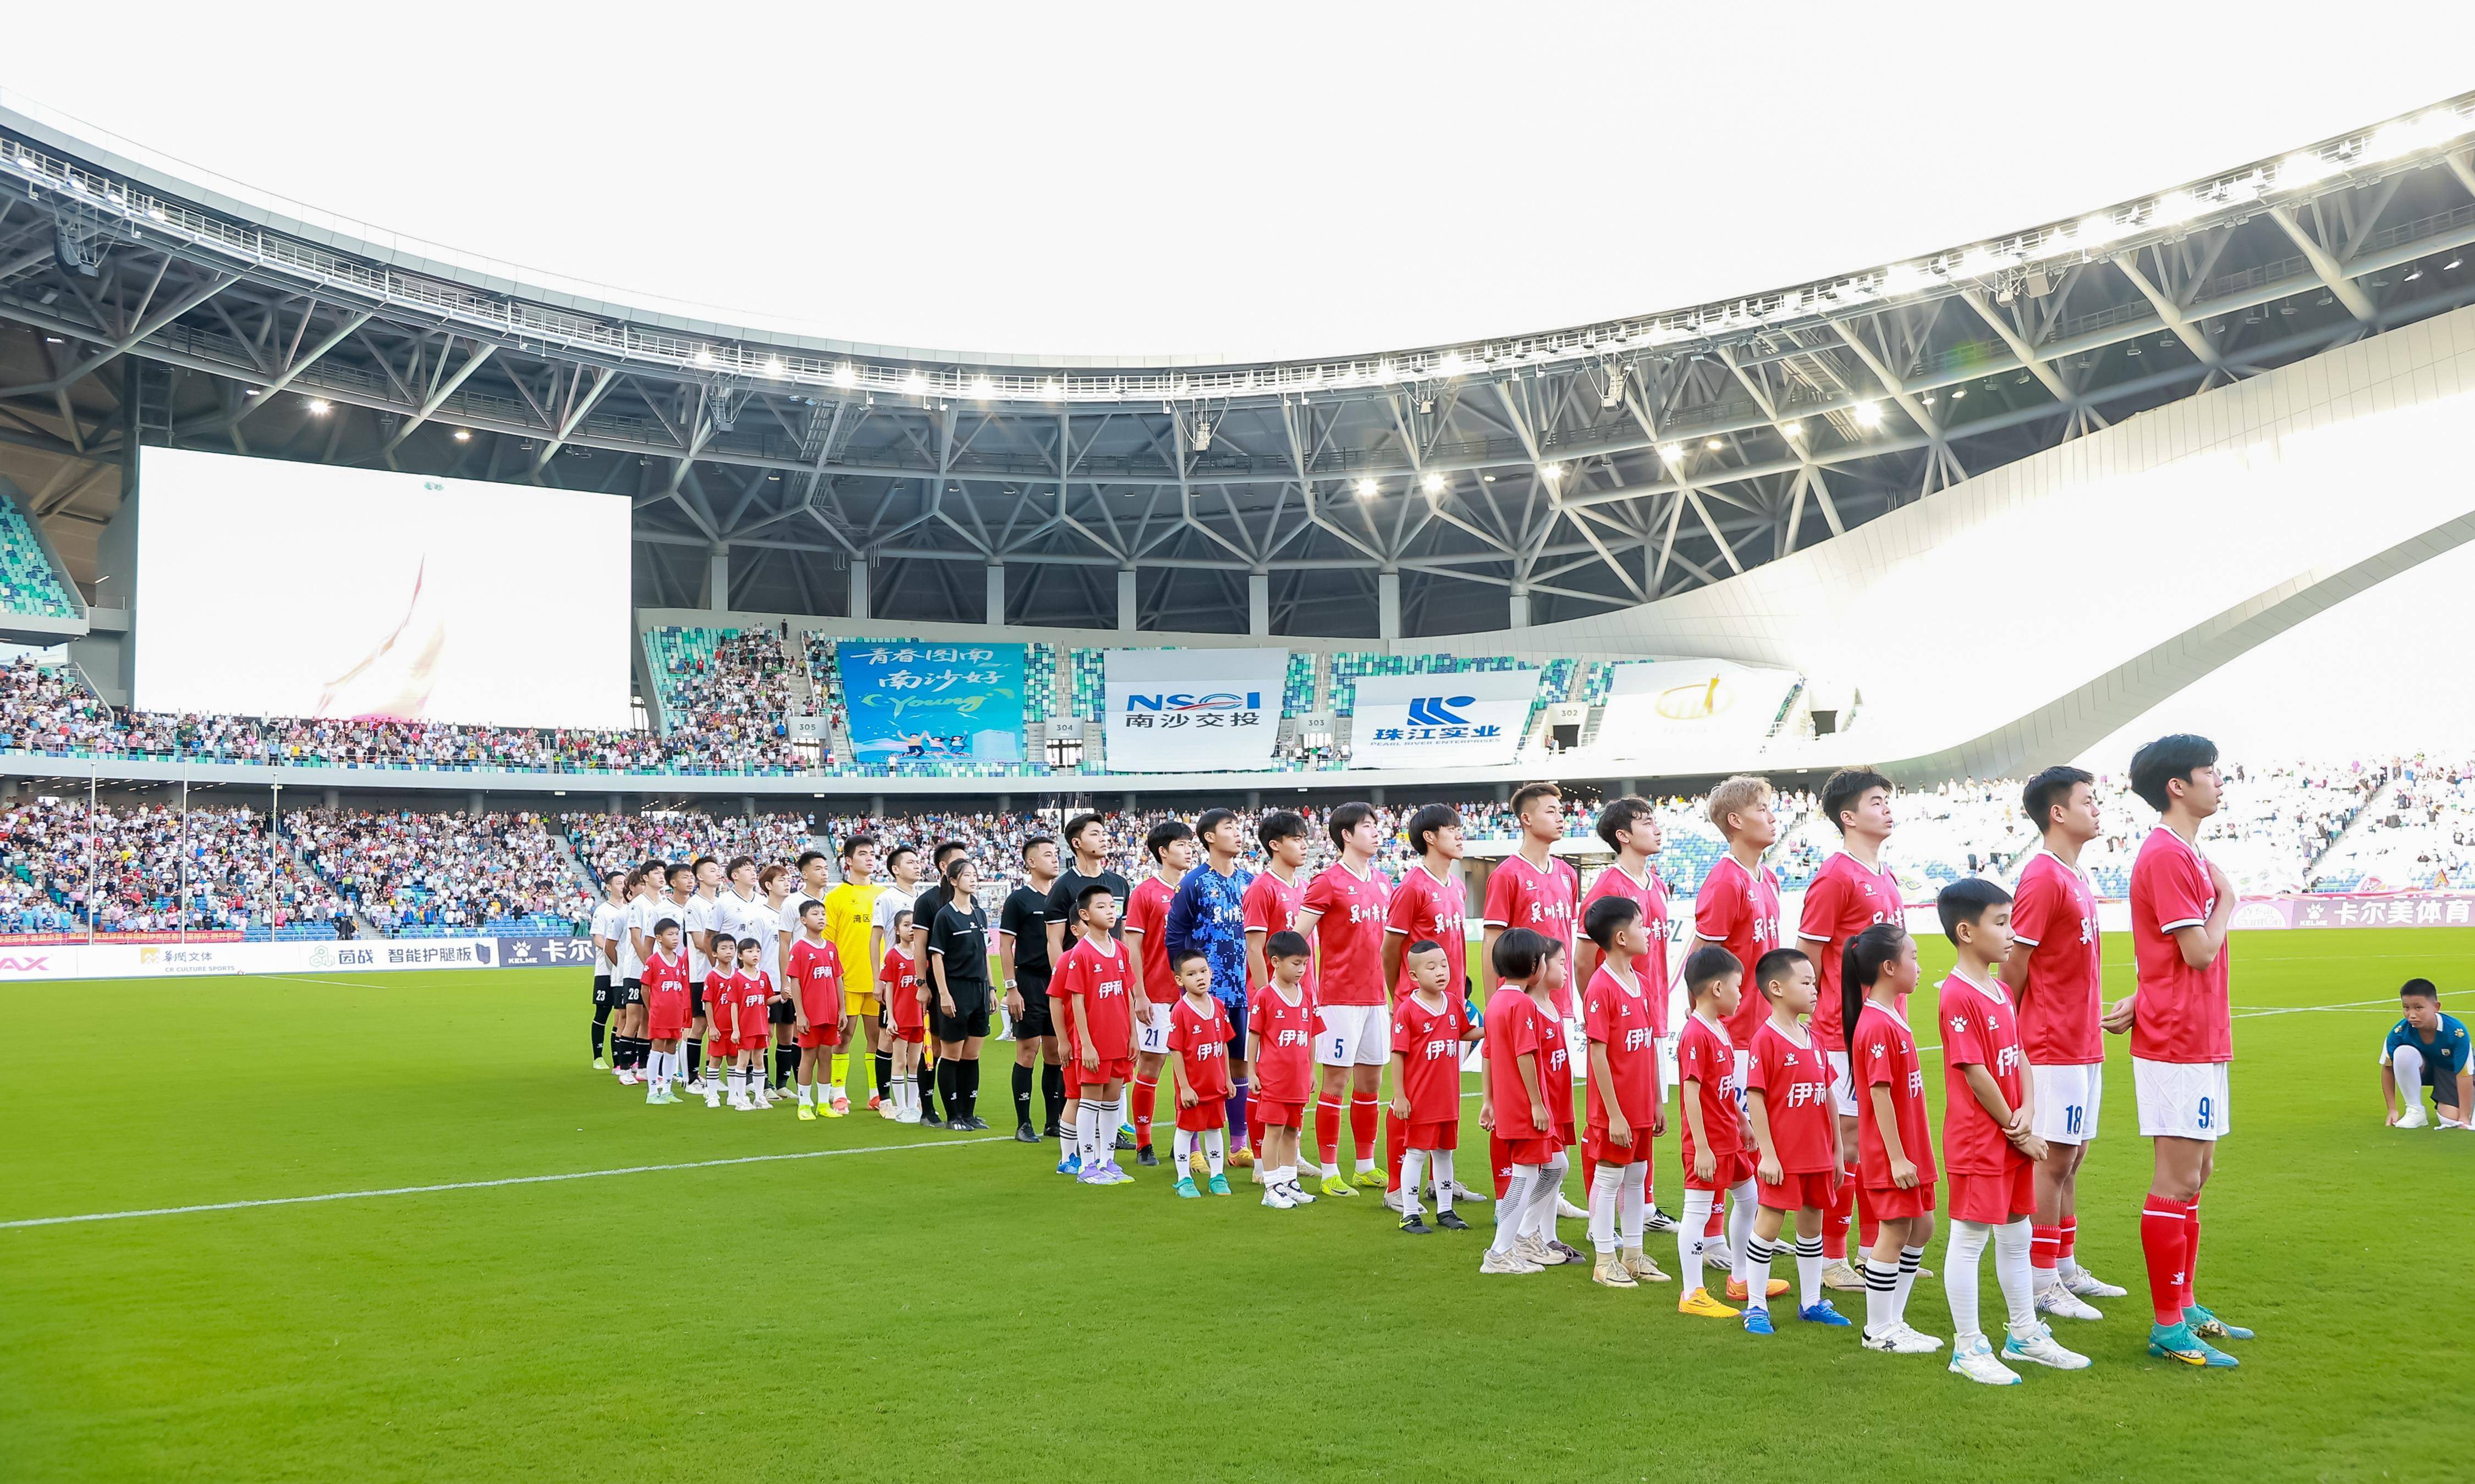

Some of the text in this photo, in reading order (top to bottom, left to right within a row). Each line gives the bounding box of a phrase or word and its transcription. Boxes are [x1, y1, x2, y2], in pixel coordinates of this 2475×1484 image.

[879, 669, 1005, 692] 南沙好
[1125, 712, 1260, 729] 南沙交投
[1373, 725, 1501, 741] 珠江实业
[2333, 900, 2473, 925] 卡尔美体育
[388, 947, 472, 963] 智能护腿板
[541, 939, 594, 963] 卡尔
[596, 990, 606, 1001] 23
[628, 988, 640, 1000] 28
[1145, 1028, 1159, 1047] 21
[1278, 1029, 1308, 1048] 伊利
[1197, 1040, 1223, 1062] 伊利
[1334, 1038, 1344, 1059] 5
[2066, 1105, 2083, 1135] 18
